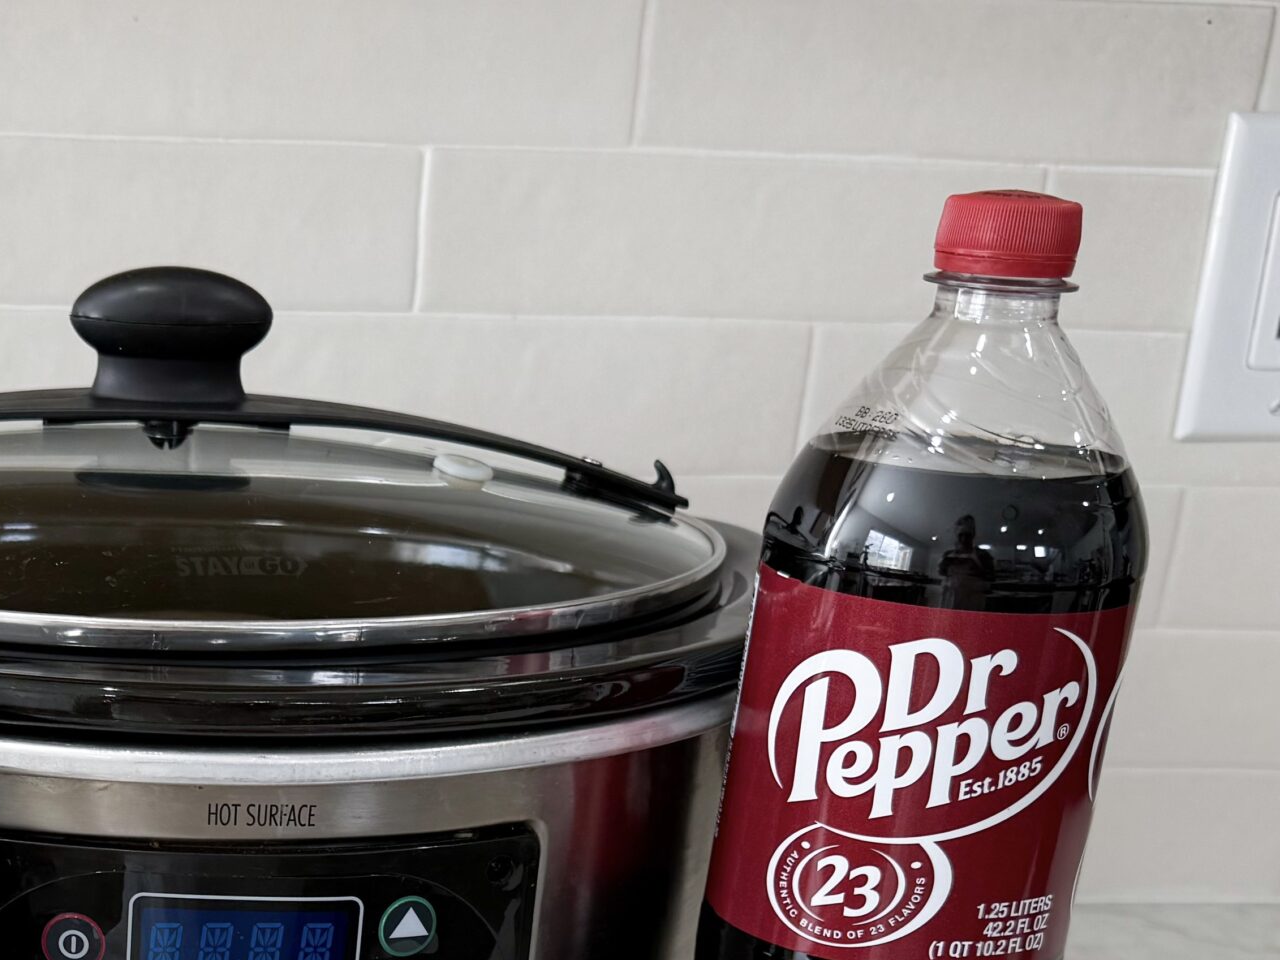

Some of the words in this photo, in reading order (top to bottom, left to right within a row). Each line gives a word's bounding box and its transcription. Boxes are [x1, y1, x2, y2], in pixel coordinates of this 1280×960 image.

[176, 556, 239, 576] STAY
[880, 638, 1018, 733] Dr
[769, 649, 1080, 819] Pepper
[208, 803, 241, 826] HOT
[246, 804, 317, 827] SURFACE
[779, 850, 799, 918] AUTHENTIC
[799, 919, 842, 939] BLEND
[846, 930, 865, 939] OF
[869, 924, 885, 935] 23
[889, 877, 926, 927] FLAVORS
[810, 855, 882, 918] 23
[977, 902, 1009, 919] 1.25
[1010, 895, 1053, 917] LITERS
[983, 920, 1015, 938] 42.2
[1016, 918, 1031, 935] FL
[1033, 913, 1050, 930] OZ
[928, 940, 945, 960] (1
[949, 941, 973, 958] QT
[975, 940, 1006, 957] 10.2
[1007, 937, 1023, 954] FL
[1025, 932, 1044, 951] OZ)
